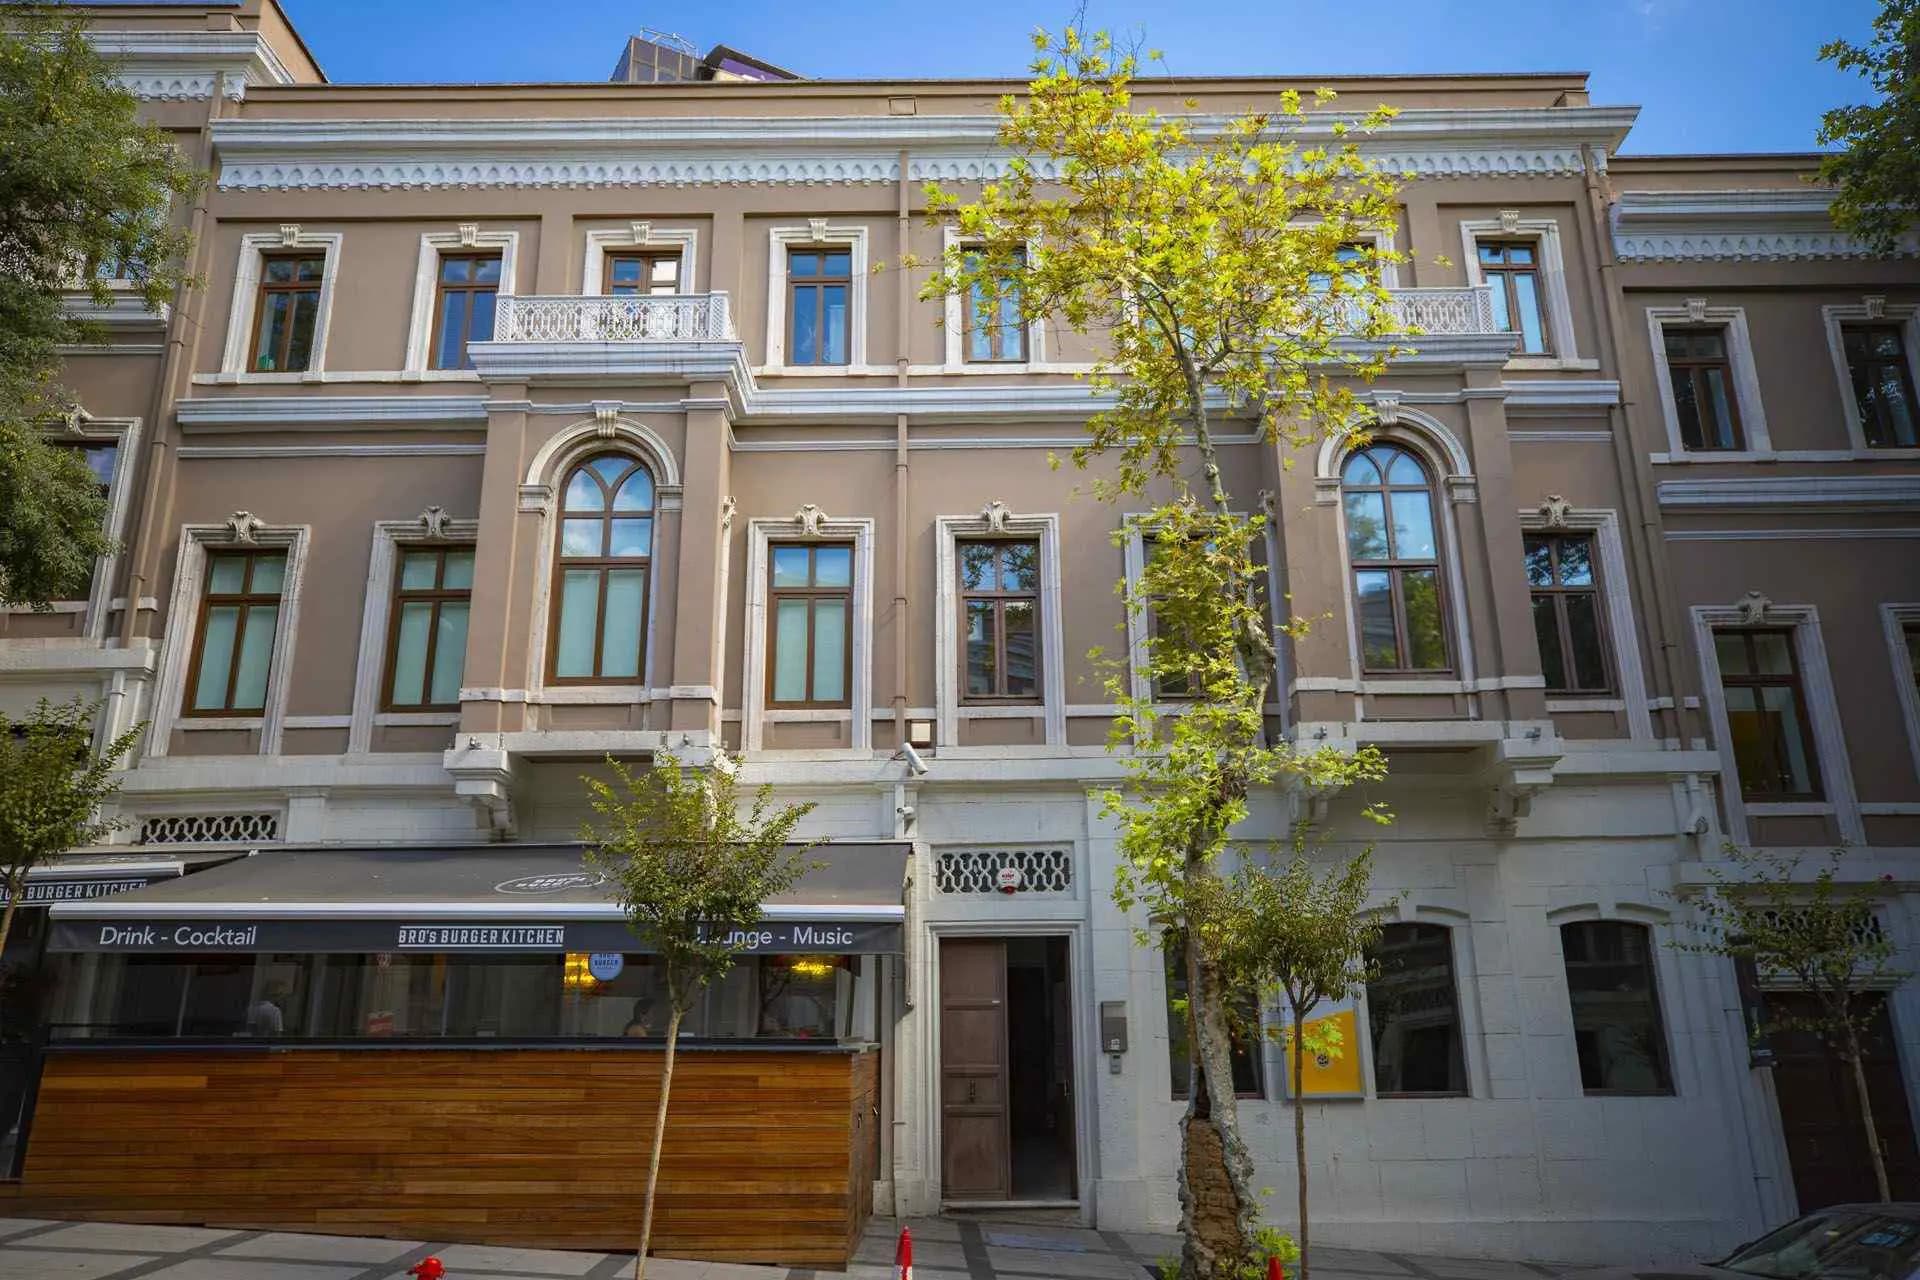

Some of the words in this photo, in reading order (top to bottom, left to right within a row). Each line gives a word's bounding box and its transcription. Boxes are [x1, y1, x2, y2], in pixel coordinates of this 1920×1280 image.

[27, 884, 83, 900] BURGER
[99, 925, 156, 945] Drink
[174, 925, 257, 945] Cocktail
[440, 929, 498, 944] BURGER
[501, 929, 564, 944] KITCHEN
[793, 926, 853, 944] Music
